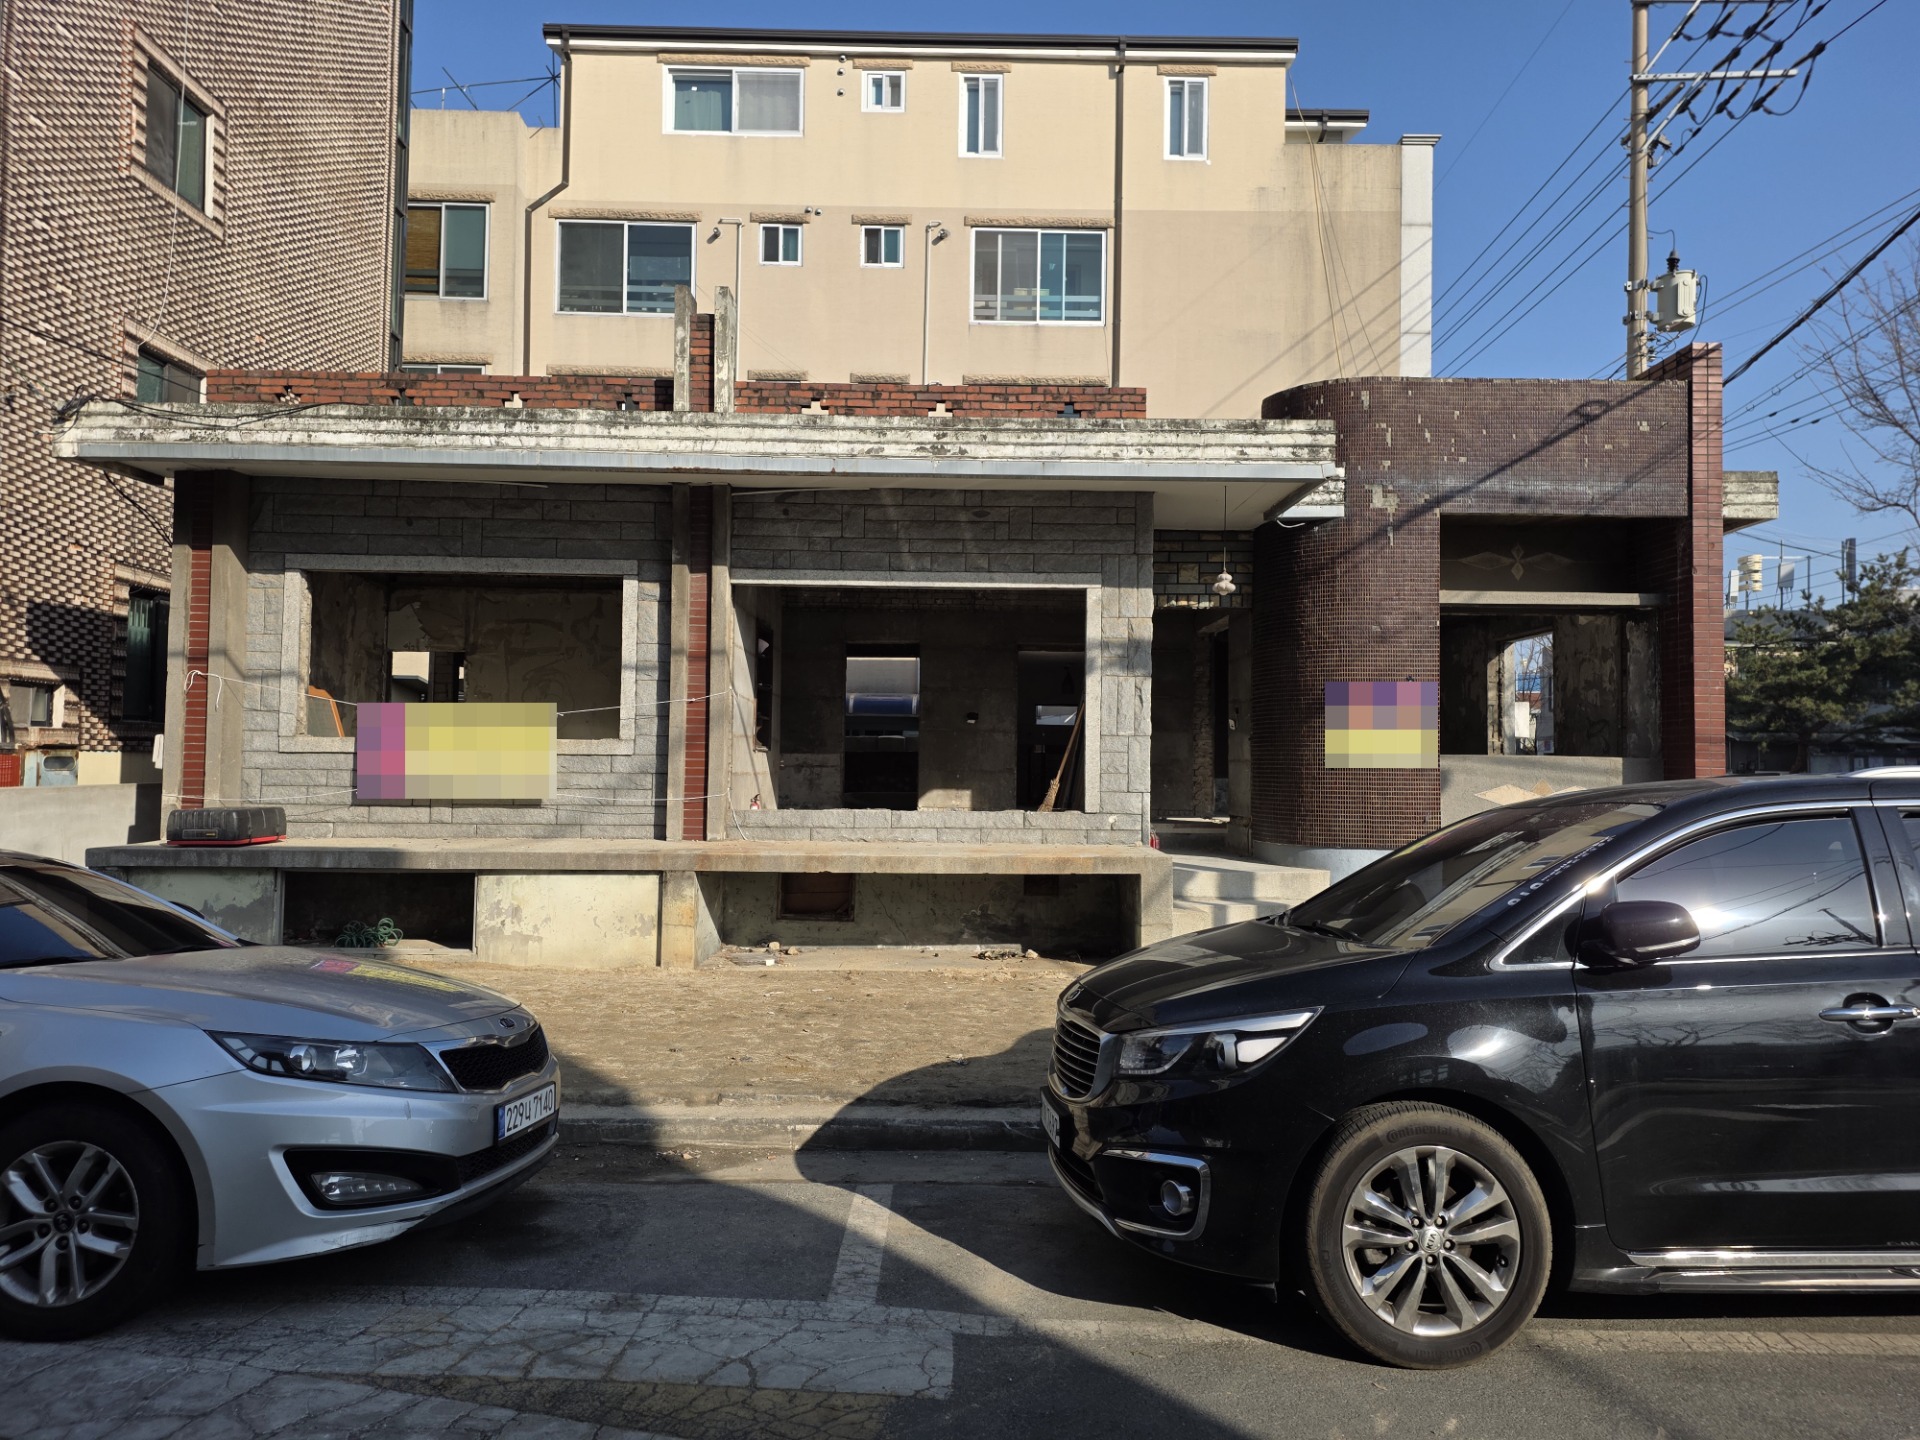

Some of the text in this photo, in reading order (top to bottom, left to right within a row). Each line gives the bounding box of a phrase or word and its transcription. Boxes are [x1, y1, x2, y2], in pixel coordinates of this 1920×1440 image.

[506, 1089, 553, 1133] 229나 7140
[1426, 1233, 1437, 1249] KIA
